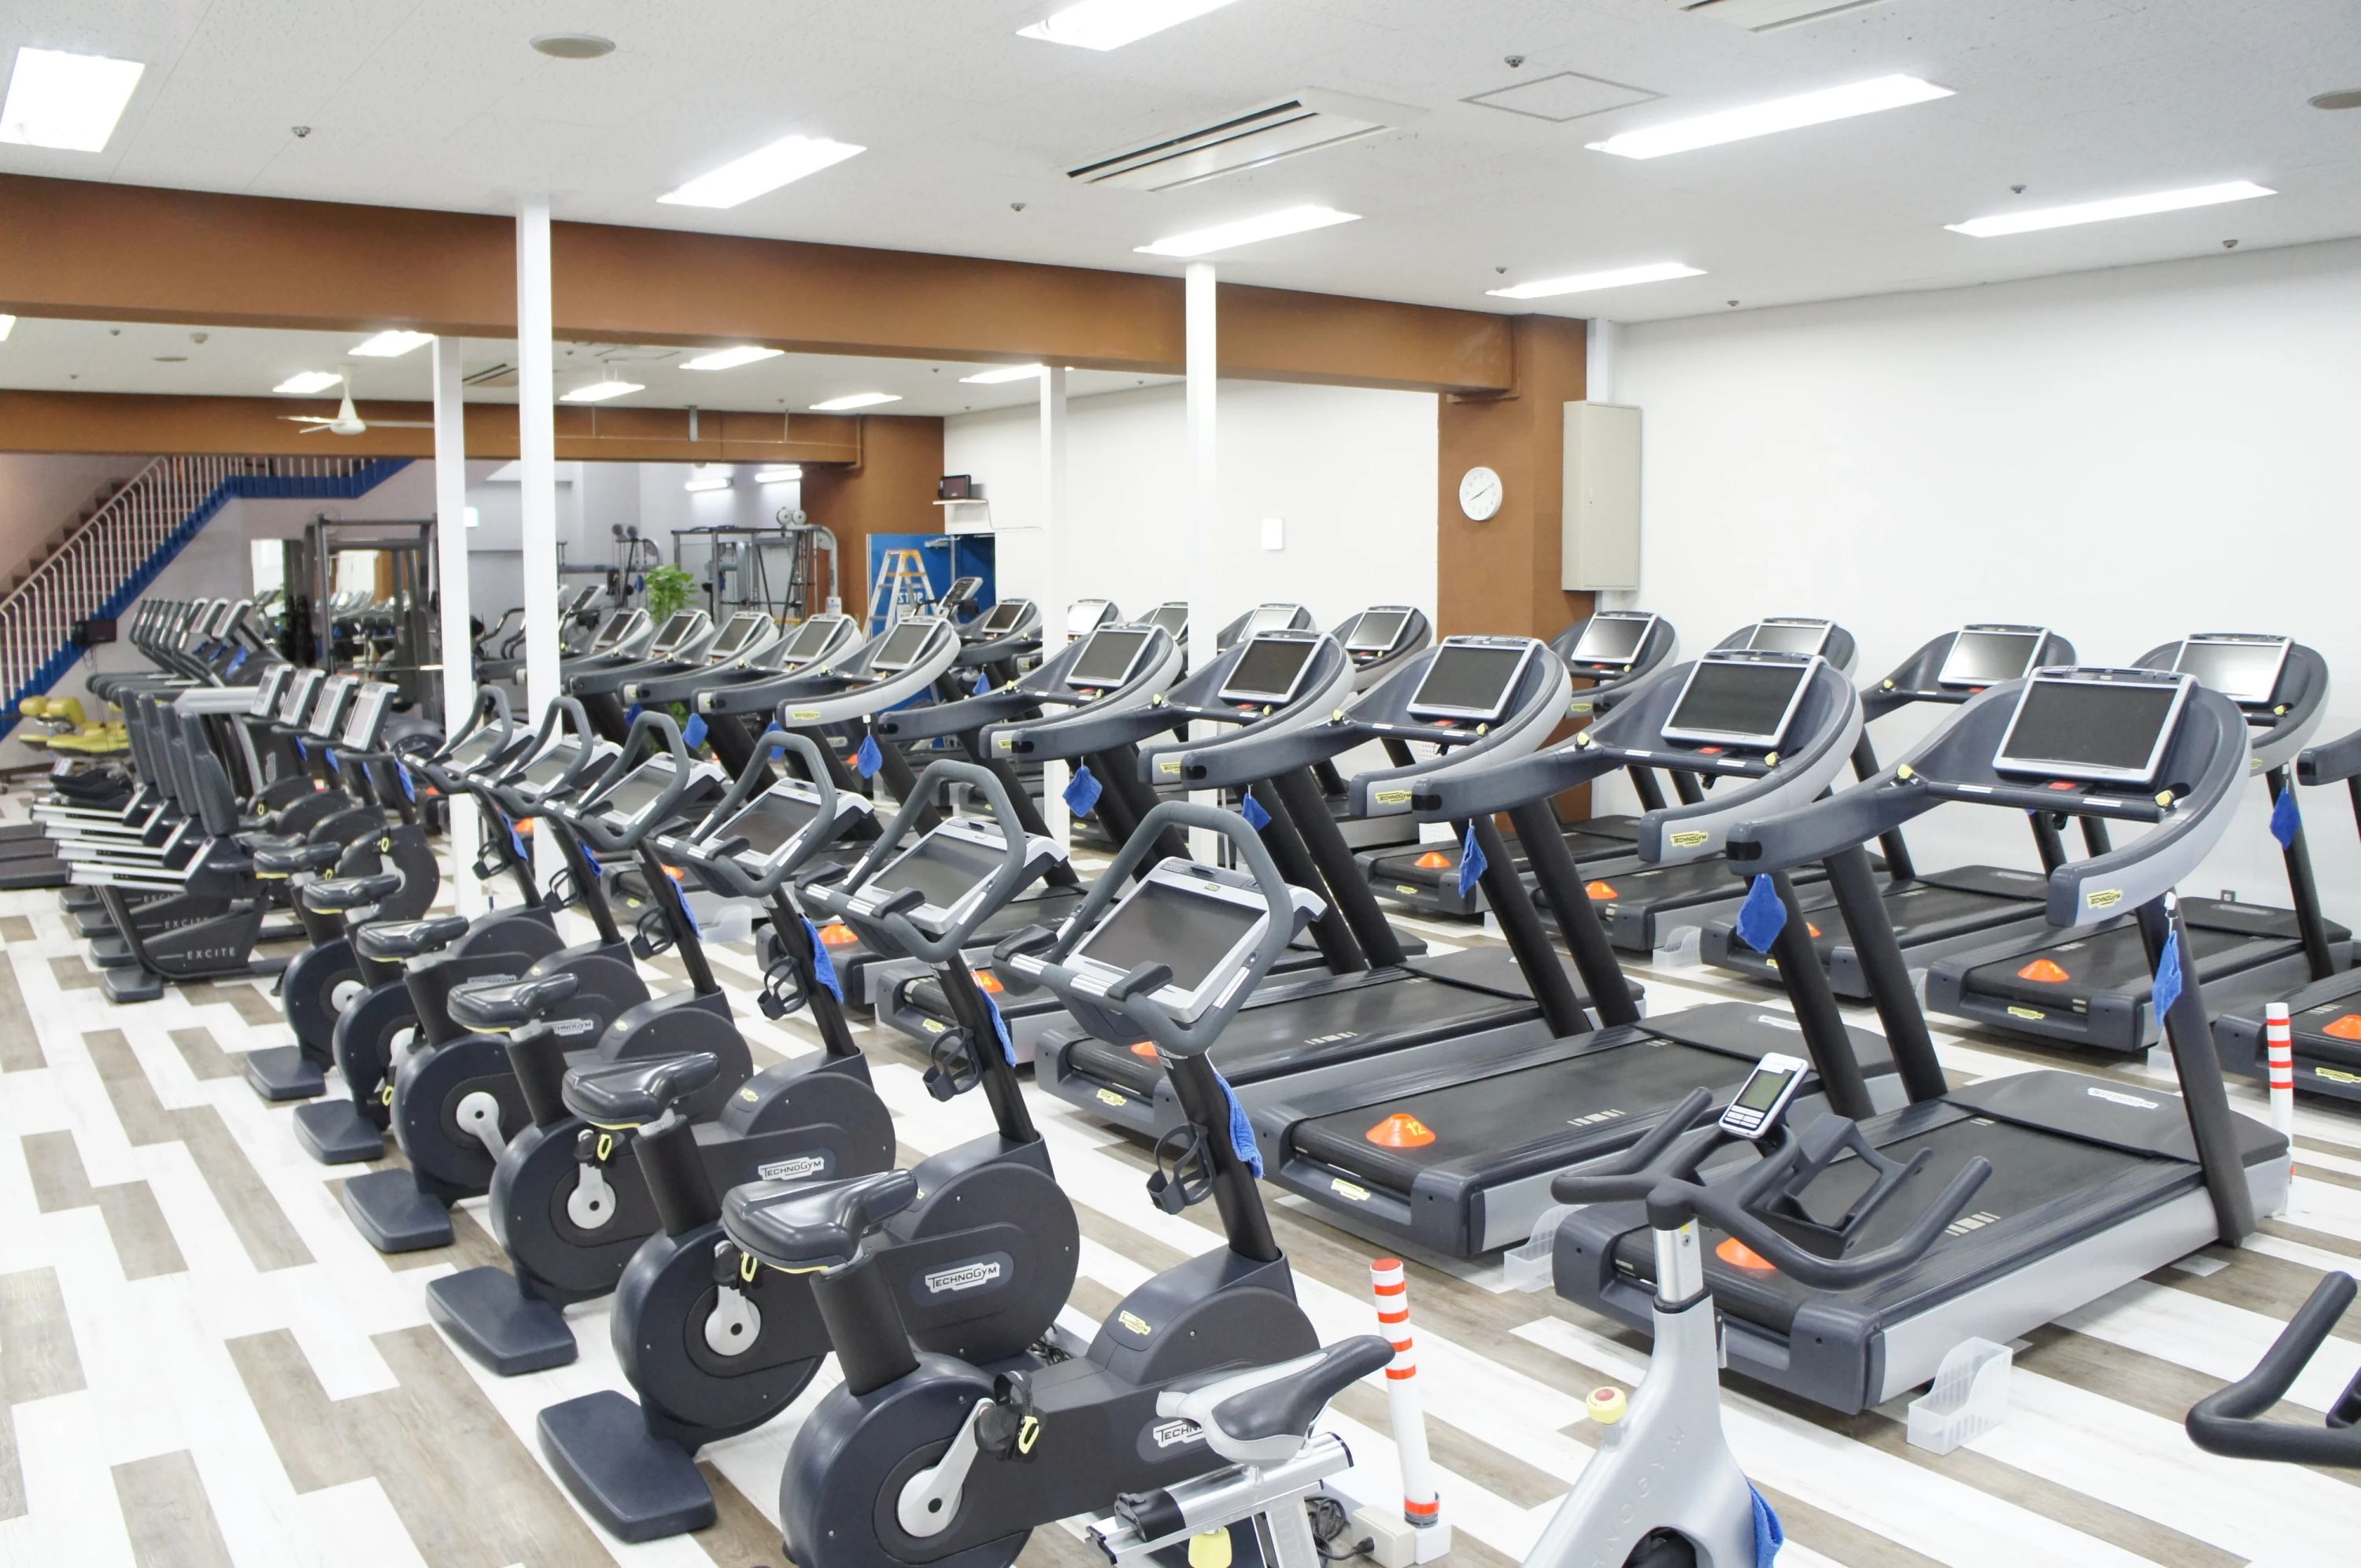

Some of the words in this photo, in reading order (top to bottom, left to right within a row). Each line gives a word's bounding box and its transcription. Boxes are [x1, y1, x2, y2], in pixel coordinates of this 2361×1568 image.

[1376, 791, 1411, 802] TECHNOGYM
[1672, 833, 1707, 844] TECHNOGYM
[2089, 891, 2121, 906] TECHNOGYM
[187, 946, 235, 960] EXCITE
[1406, 1120, 1426, 1136] 12
[760, 1160, 822, 1179] TECHNOGYM
[928, 1266, 997, 1289] TECHNOGYM
[1155, 1422, 1203, 1442] TECHN
